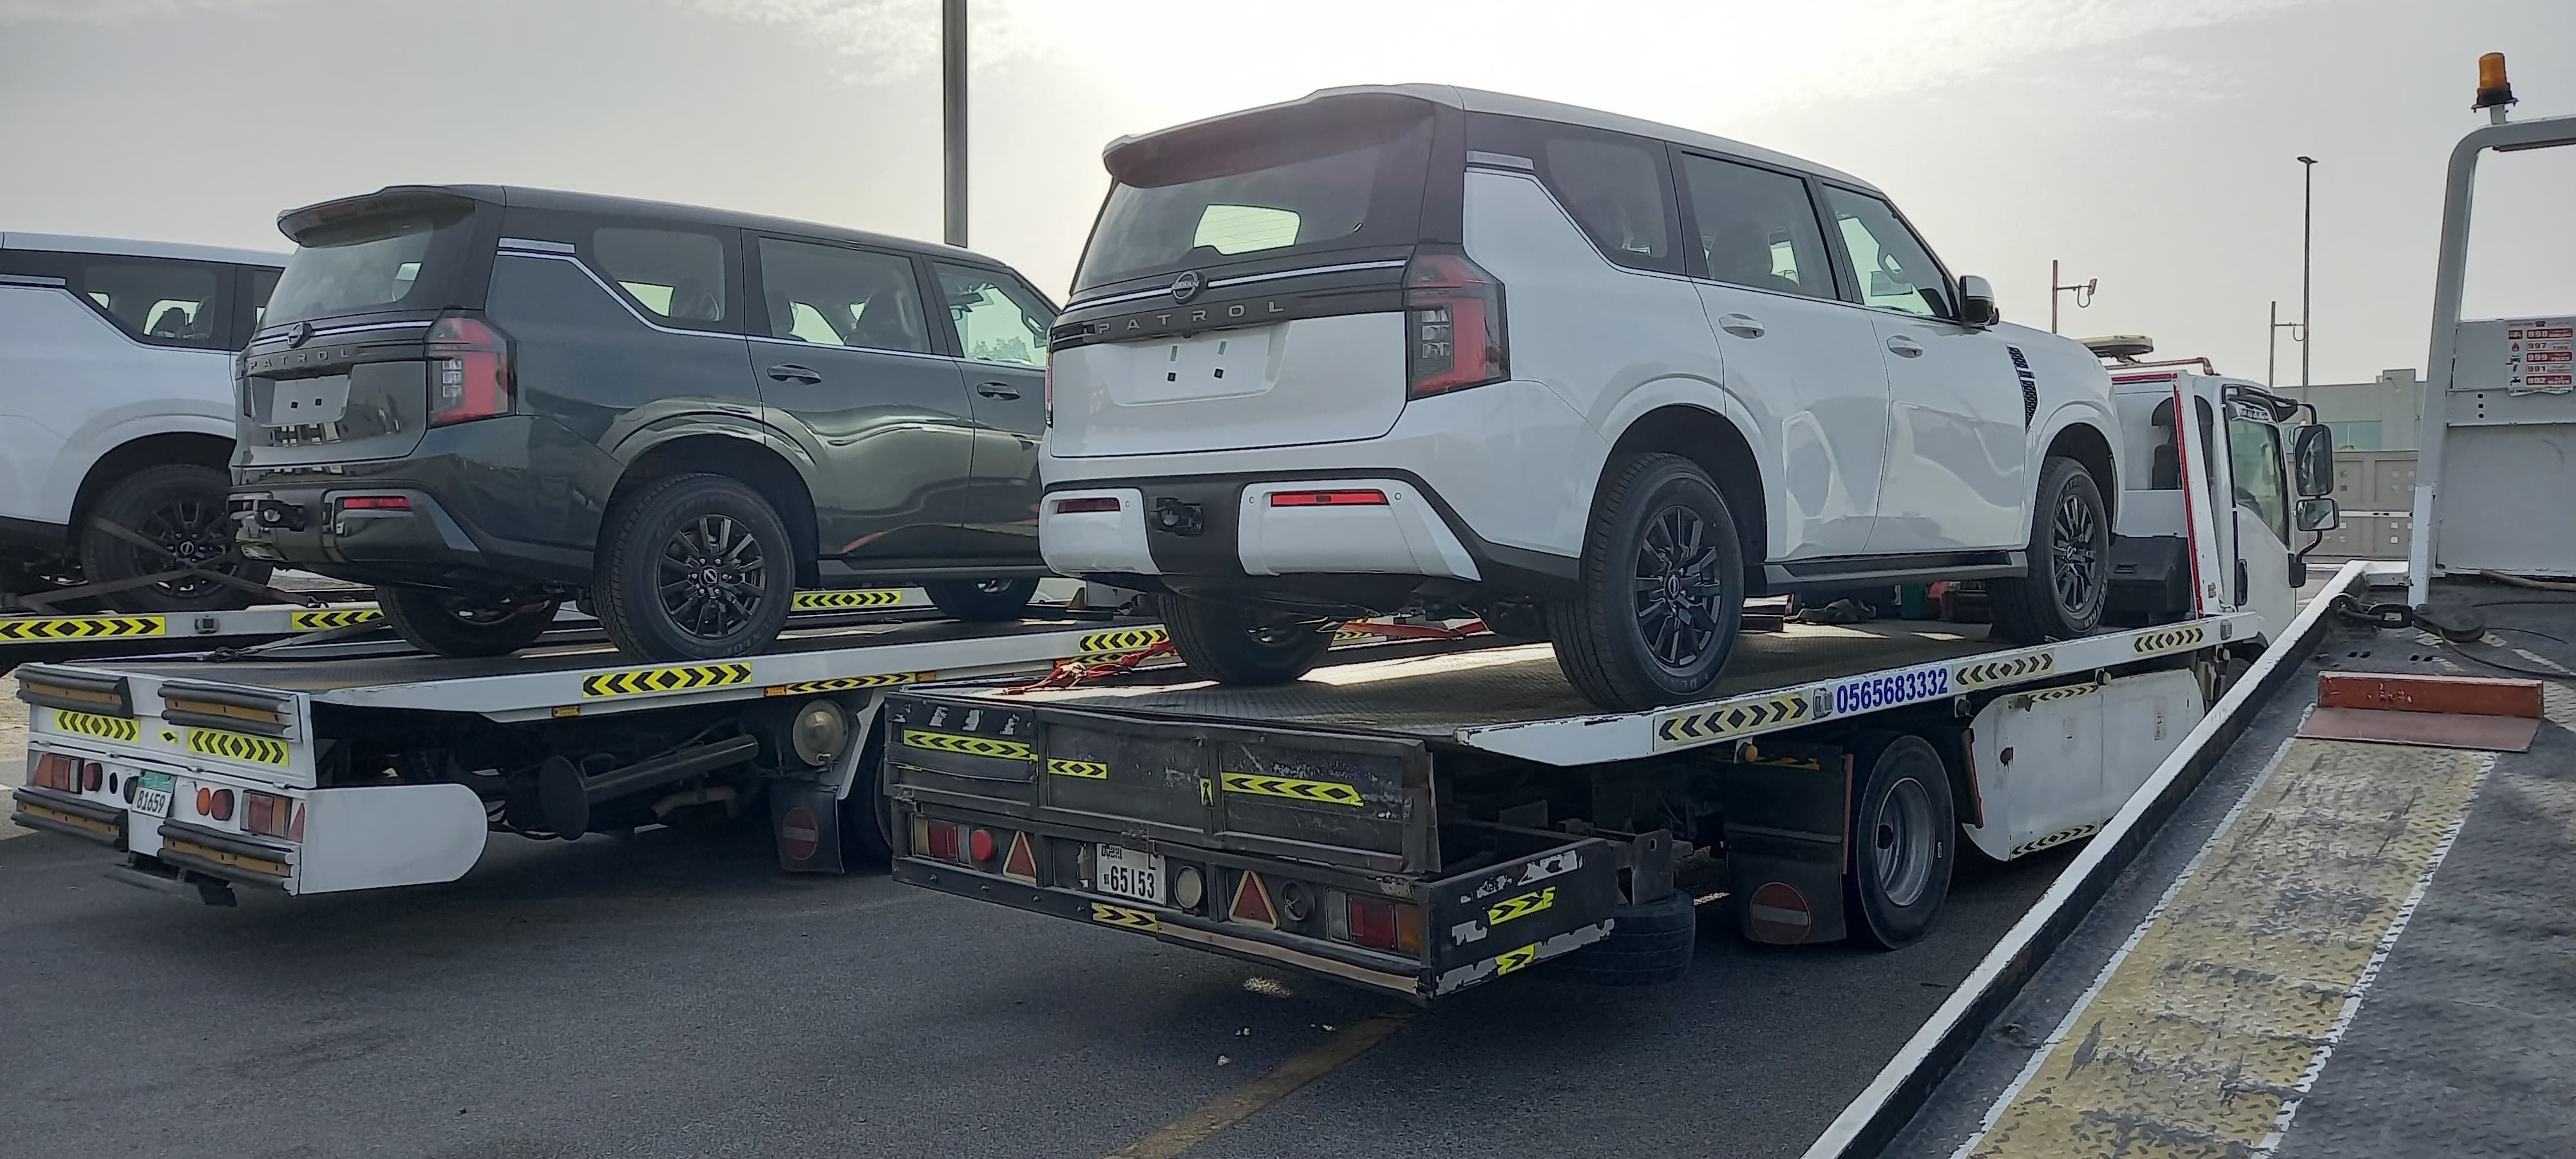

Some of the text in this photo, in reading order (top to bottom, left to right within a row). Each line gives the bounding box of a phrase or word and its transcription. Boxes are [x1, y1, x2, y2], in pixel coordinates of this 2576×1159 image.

[1098, 301, 1284, 335] PATROL
[248, 348, 350, 370] PATROL
[1836, 668, 1948, 713] 0565683332
[137, 790, 166, 813] 81659
[1110, 865, 1155, 899] 65153
